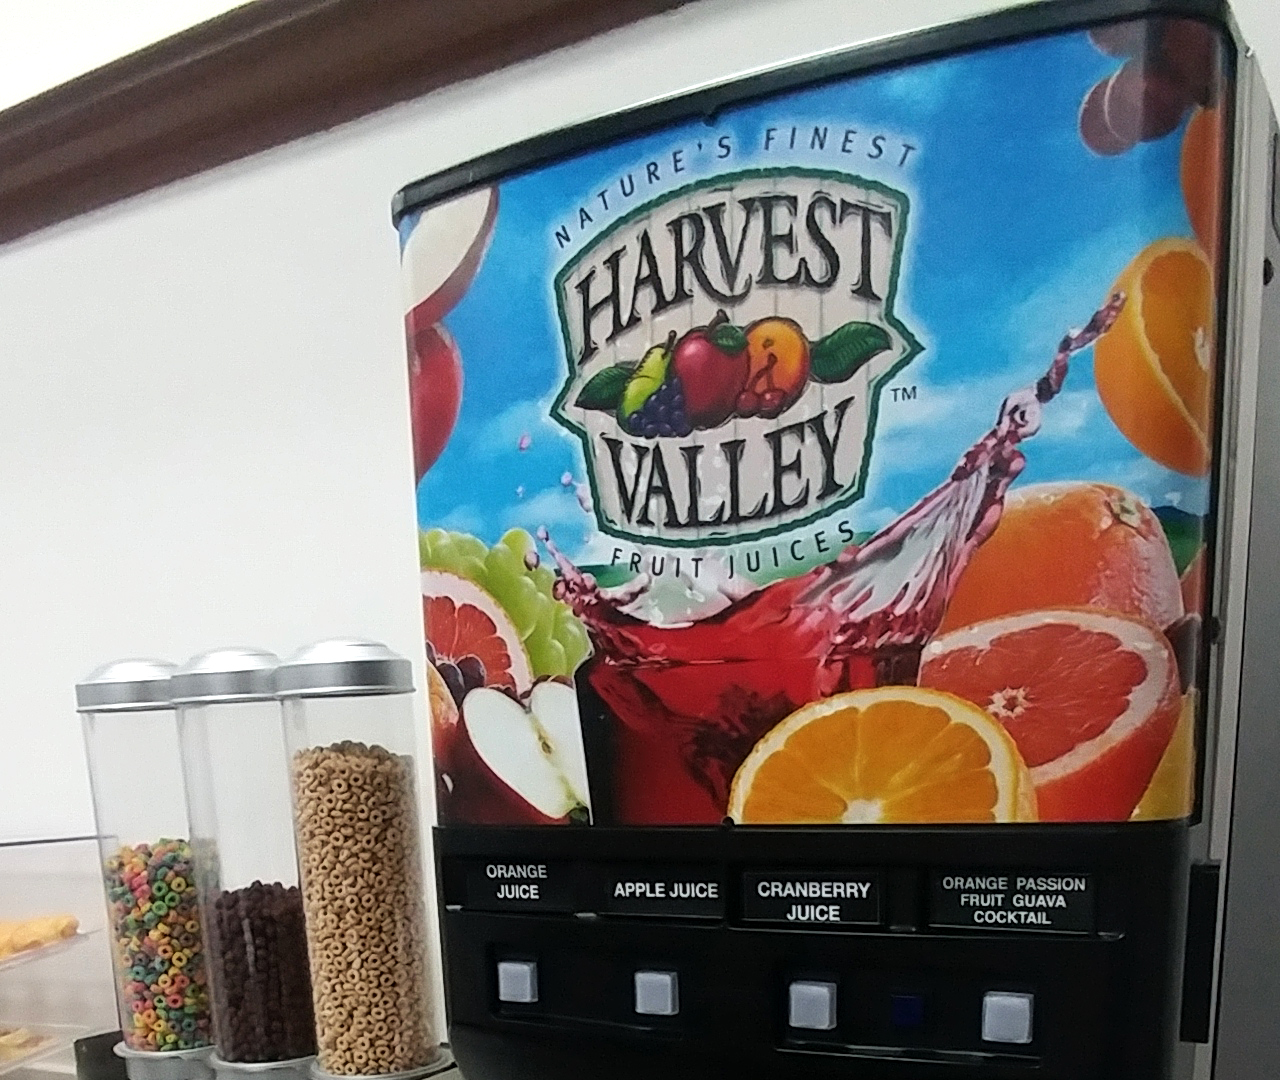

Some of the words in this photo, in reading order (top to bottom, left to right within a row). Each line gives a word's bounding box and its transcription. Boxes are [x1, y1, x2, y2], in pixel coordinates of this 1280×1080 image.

[555, 136, 734, 249] NATURE'S
[763, 127, 918, 168] FINEST
[575, 190, 894, 366] HARVEST
[890, 386, 918, 402] TM
[599, 396, 856, 528] VALLEY
[611, 547, 705, 579] FRUIT
[727, 520, 856, 580] JUICES
[485, 864, 548, 880] ORANGE
[496, 884, 540, 900] JUICE
[613, 881, 666, 898] APPLE
[670, 882, 719, 899] JUICE
[756, 880, 872, 900] CRANBERRY
[941, 876, 1009, 891] ORANGE
[1016, 877, 1086, 892] PASSION
[959, 893, 1004, 909] FRUIT
[1011, 894, 1067, 909] GUAVA
[785, 904, 841, 923] JUICE
[972, 909, 1052, 925] COCKTAIL
